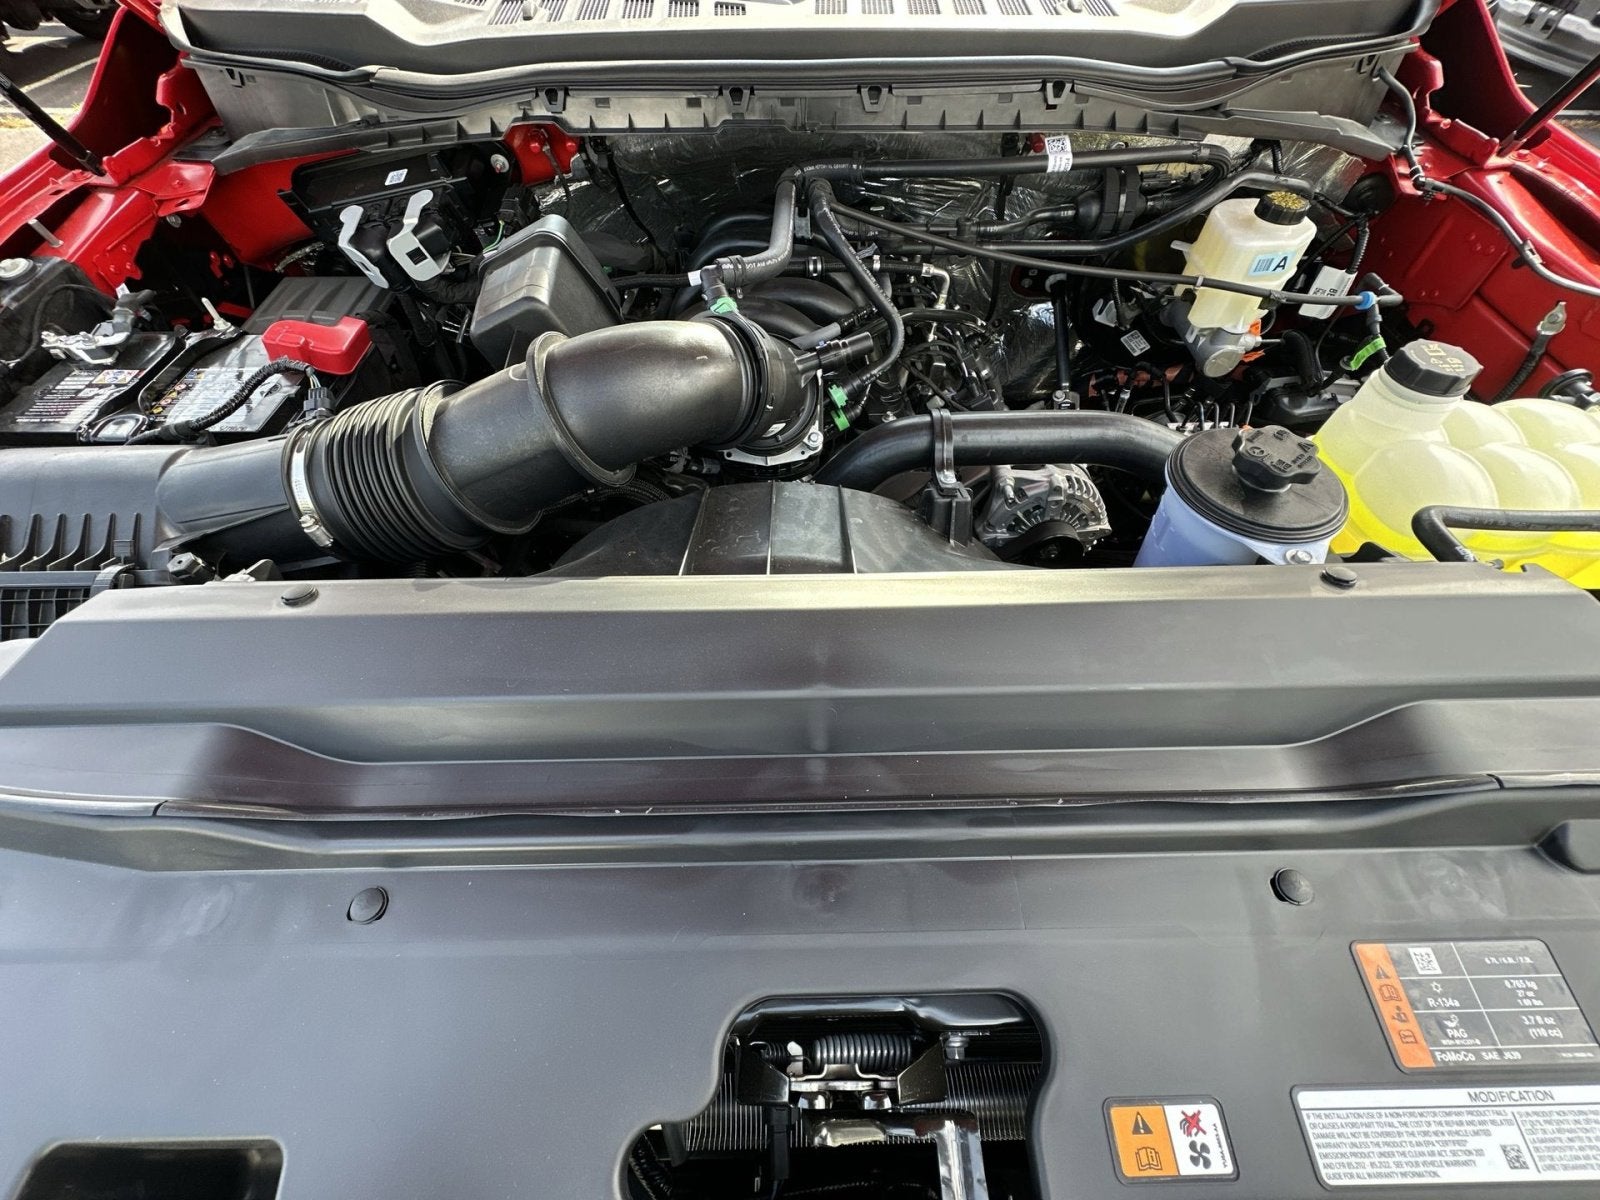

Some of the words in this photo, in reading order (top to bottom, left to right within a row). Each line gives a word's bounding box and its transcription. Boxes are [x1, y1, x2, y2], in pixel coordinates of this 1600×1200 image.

[1272, 256, 1288, 272] A
[1504, 980, 1526, 988] 0.765
[1526, 980, 1538, 990] kg
[1428, 998, 1461, 1008] R-134a
[1522, 1016, 1536, 1025] 3.7
[1446, 1029, 1468, 1038] PAG
[1528, 1028, 1548, 1039] (110
[1548, 1028, 1564, 1038] cc)
[1434, 1051, 1476, 1062] FoMoCo
[1480, 1052, 1500, 1060] SAE
[1467, 1090, 1555, 1103] MODIFICATION
